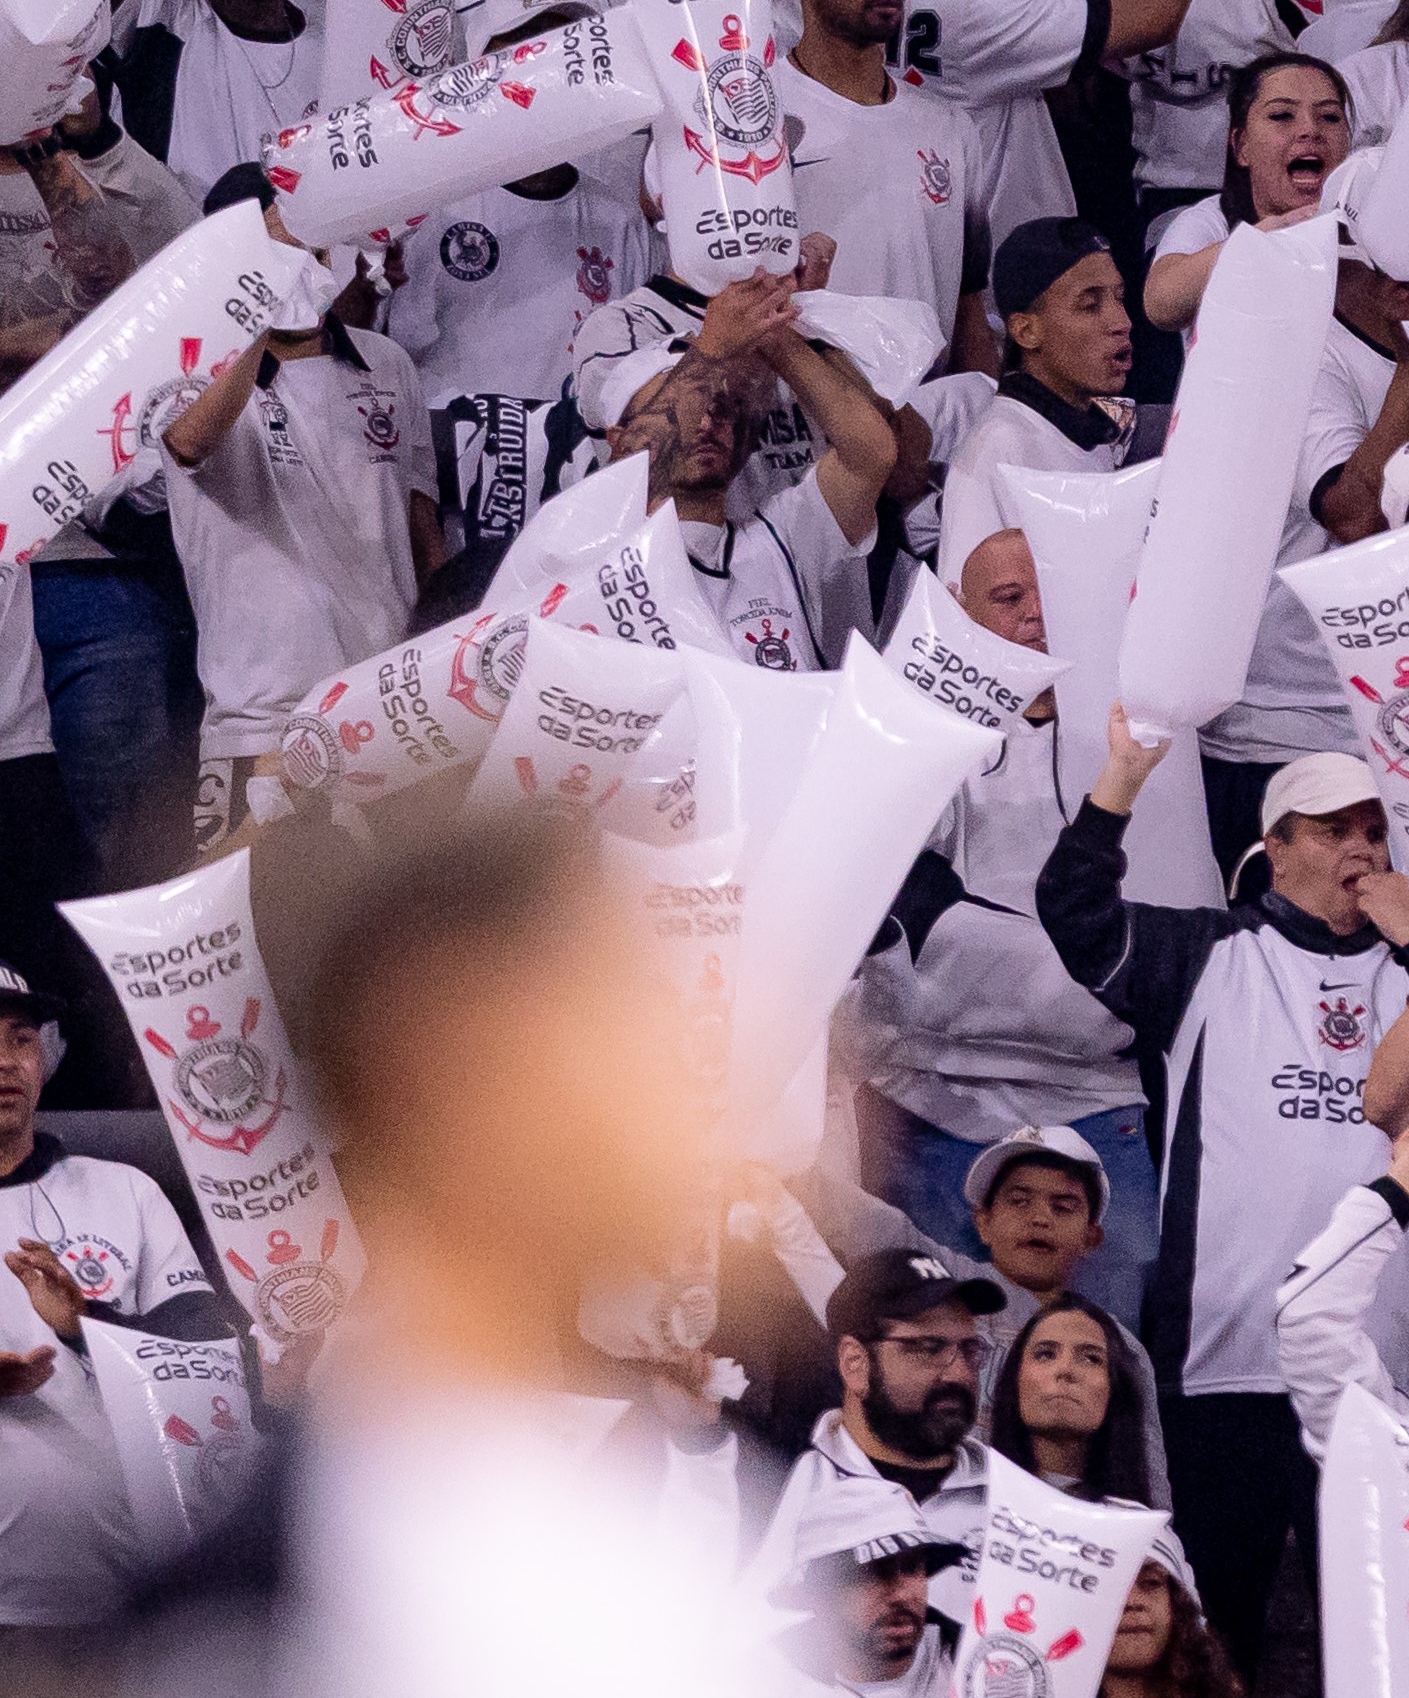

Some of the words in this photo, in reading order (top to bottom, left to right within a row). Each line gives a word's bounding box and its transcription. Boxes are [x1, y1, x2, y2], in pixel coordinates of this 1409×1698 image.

[912, 634, 1024, 713] Esportes
[112, 922, 241, 977] Esportes
[1272, 1065, 1366, 1097] Espor
